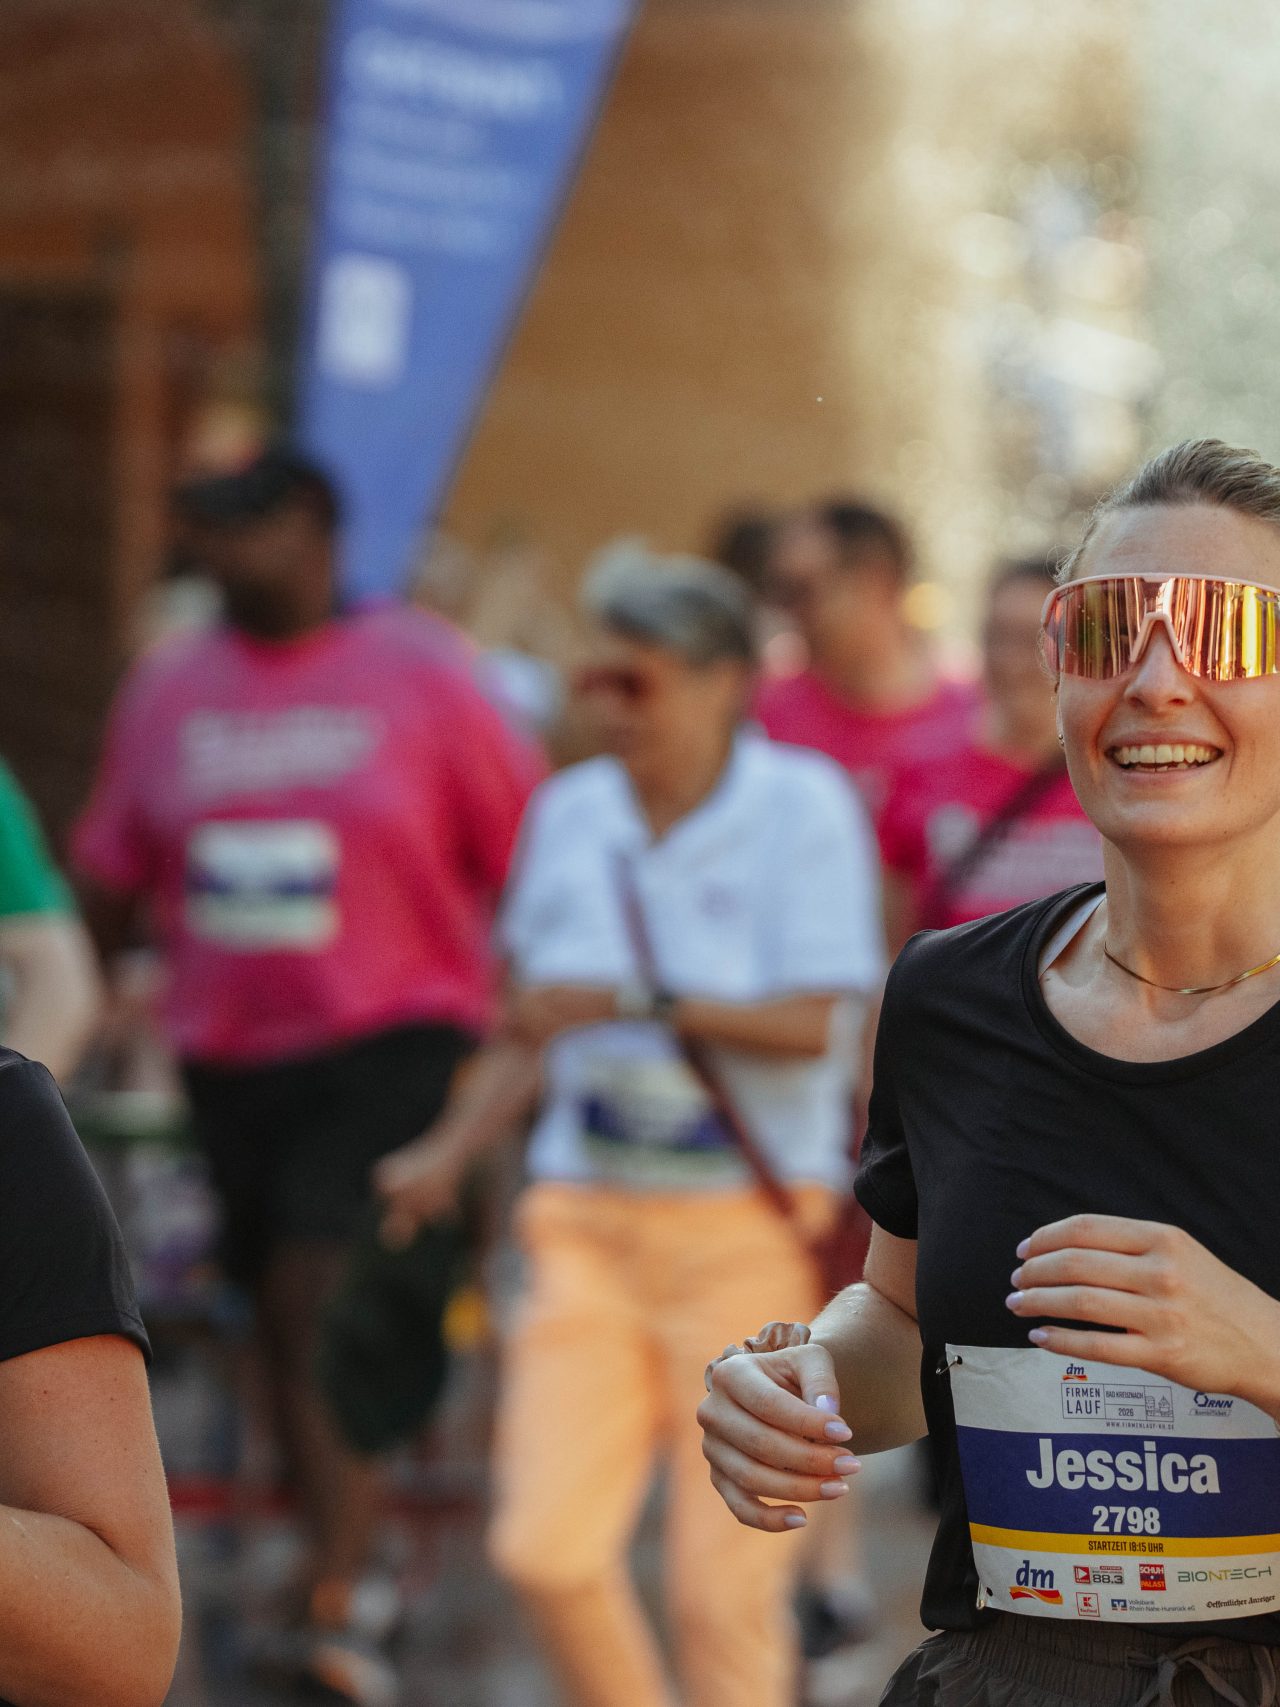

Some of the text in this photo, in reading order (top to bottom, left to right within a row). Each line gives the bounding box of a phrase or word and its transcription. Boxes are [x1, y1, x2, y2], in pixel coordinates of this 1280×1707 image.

[1066, 1363, 1085, 1375] dm
[1066, 1387, 1101, 1398] FIRMEN
[1105, 1391, 1144, 1400] BAD KREUZNACH
[1066, 1400, 1101, 1414] LAUF
[1026, 1438, 1220, 1494] Jessica
[1092, 1505, 1161, 1534] 2798
[1088, 1540, 1164, 1553] STARTZEIT 18:15 UHR
[1016, 1560, 1054, 1589] dm
[1139, 1566, 1164, 1574] SCHUH
[1177, 1566, 1272, 1583] BIONTECH
[1092, 1574, 1123, 1584] 88.3
[1140, 1580, 1165, 1588] PALAST
[1206, 1599, 1247, 1608] Oeffentlicher
